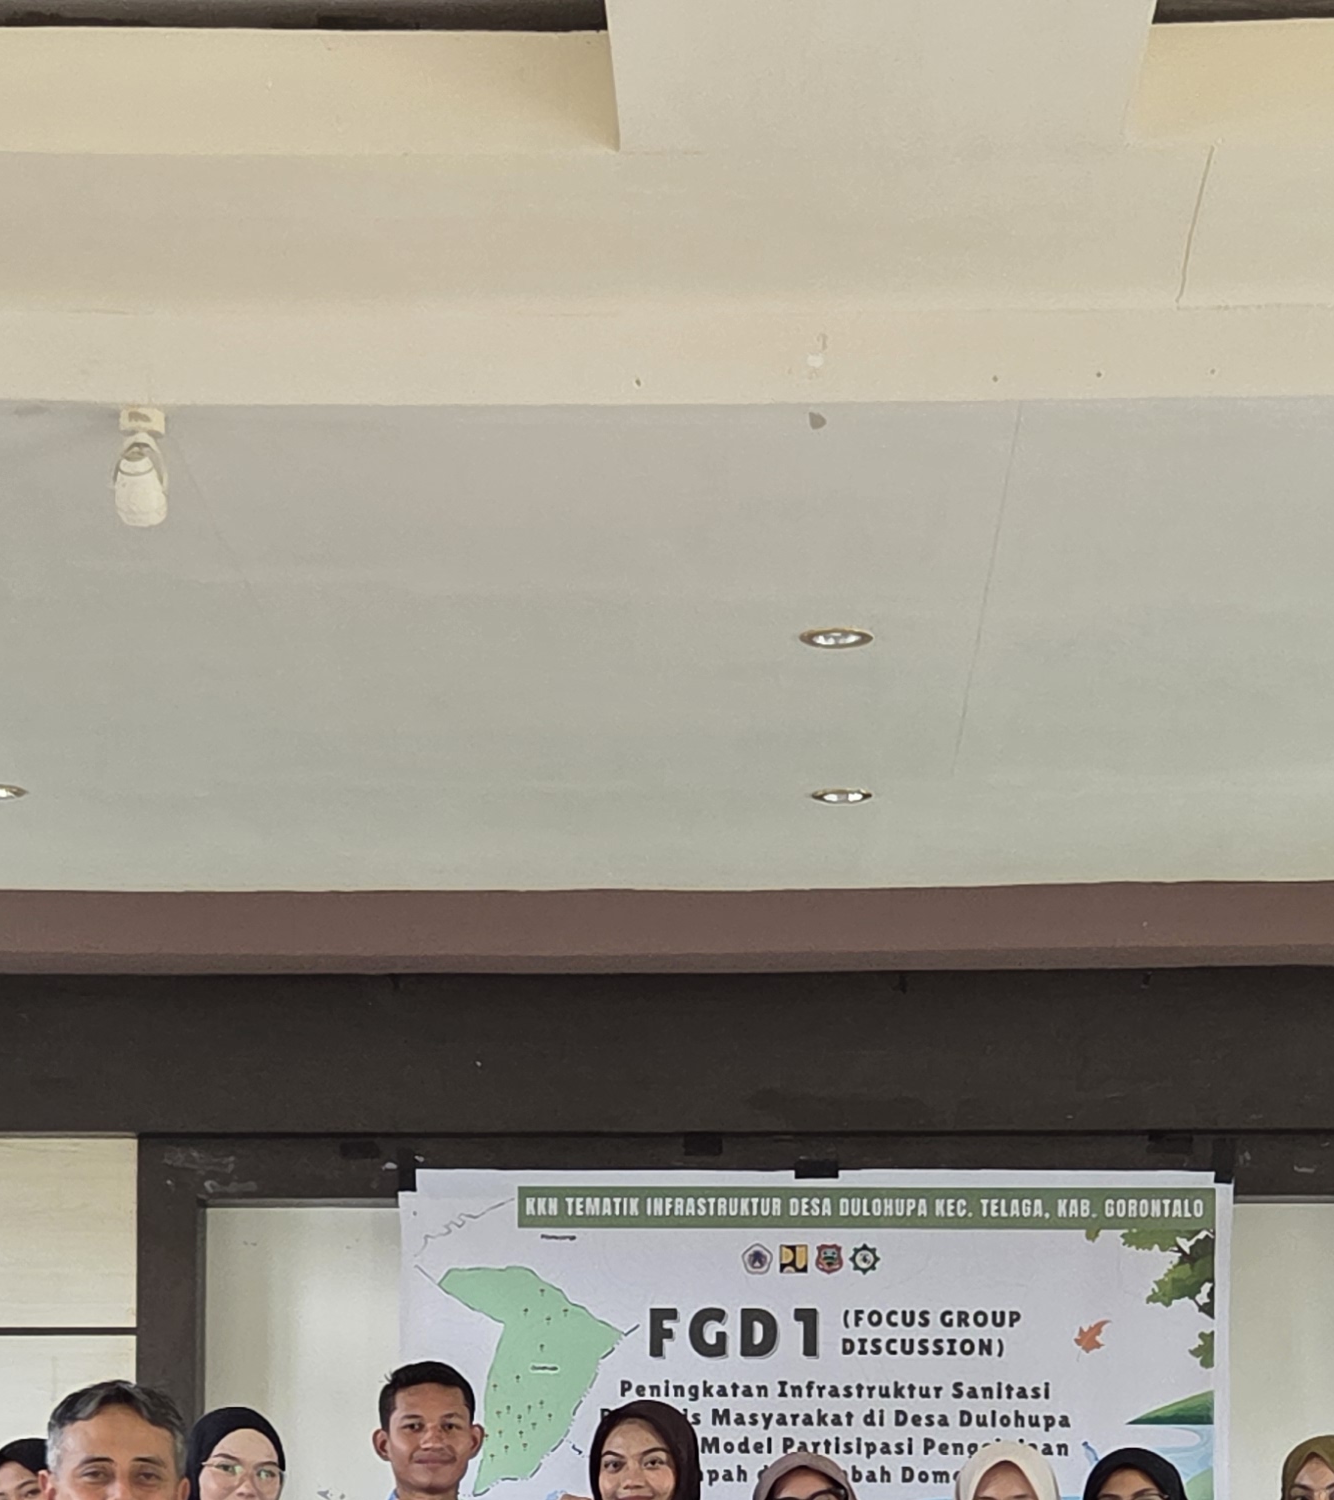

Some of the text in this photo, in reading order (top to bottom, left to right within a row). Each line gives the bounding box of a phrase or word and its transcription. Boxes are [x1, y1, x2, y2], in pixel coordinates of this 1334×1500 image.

[525, 1197, 1204, 1220] KKN TEMATIK INFRASTRUKTUR DESA DULOHUPA KEC. TELAGA, KAB. GORONTALO
[842, 1309, 1022, 1329] (FOCUS GROUP
[649, 1307, 779, 1359] FGD
[841, 1337, 1004, 1358] DISCUSSION)
[620, 1380, 1051, 1401] Peningkatan Infrastruktur Sanitasi
[711, 1408, 855, 1430] Masyarakat
[862, 1409, 885, 1428] di
[894, 1409, 950, 1428] Desa
[959, 1409, 1071, 1432] Dulohupa
[700, 1436, 772, 1454] Model
[782, 1436, 914, 1459] Partisipasi
